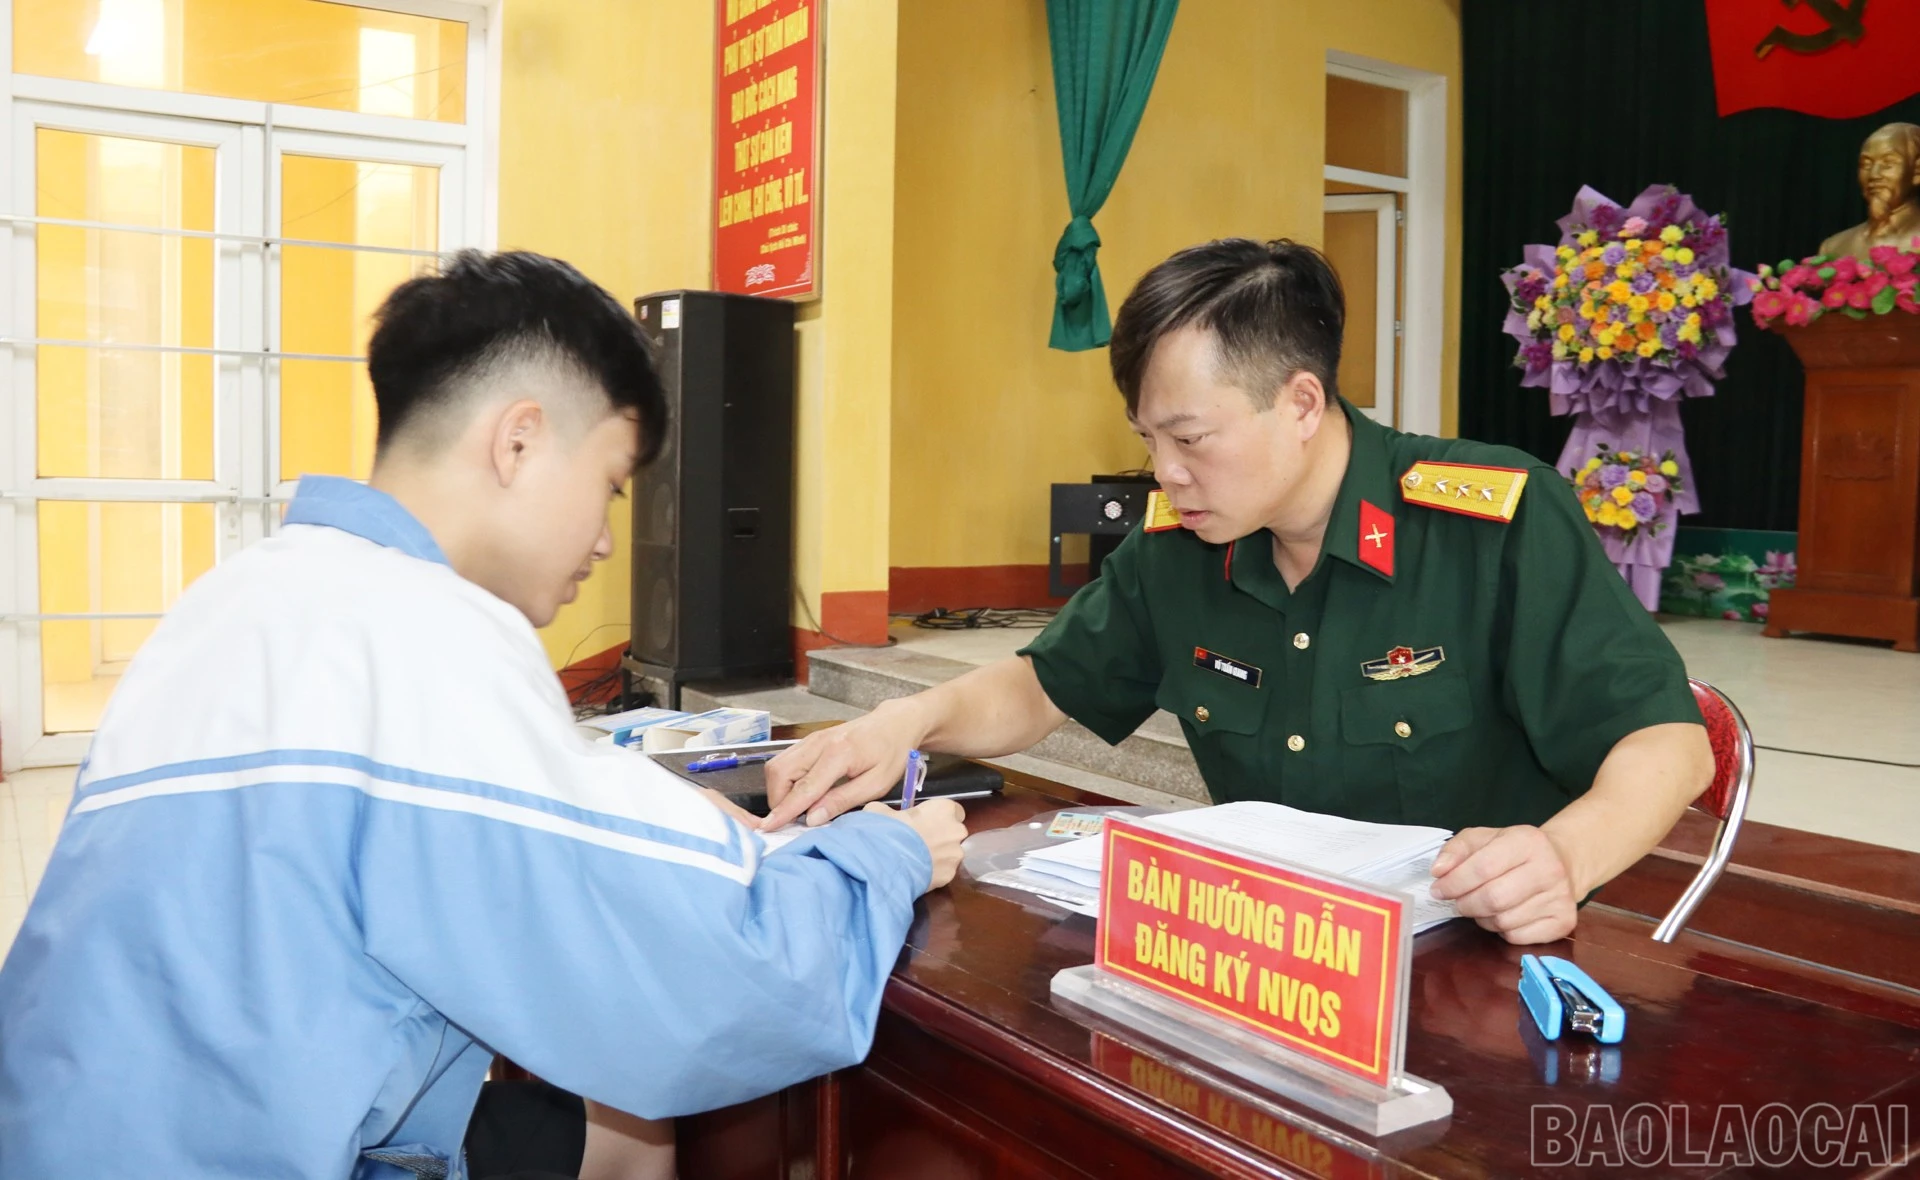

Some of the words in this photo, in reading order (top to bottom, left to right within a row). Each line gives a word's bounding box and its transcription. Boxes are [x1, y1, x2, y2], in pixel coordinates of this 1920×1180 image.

[1127, 857, 1182, 915] BÀN
[1188, 878, 1285, 951] HƯỚNG
[1293, 902, 1361, 977] DẪN
[1135, 921, 1206, 988] ĐĂNG
[1213, 951, 1251, 1003] KÝ
[1258, 967, 1341, 1039] NVQS
